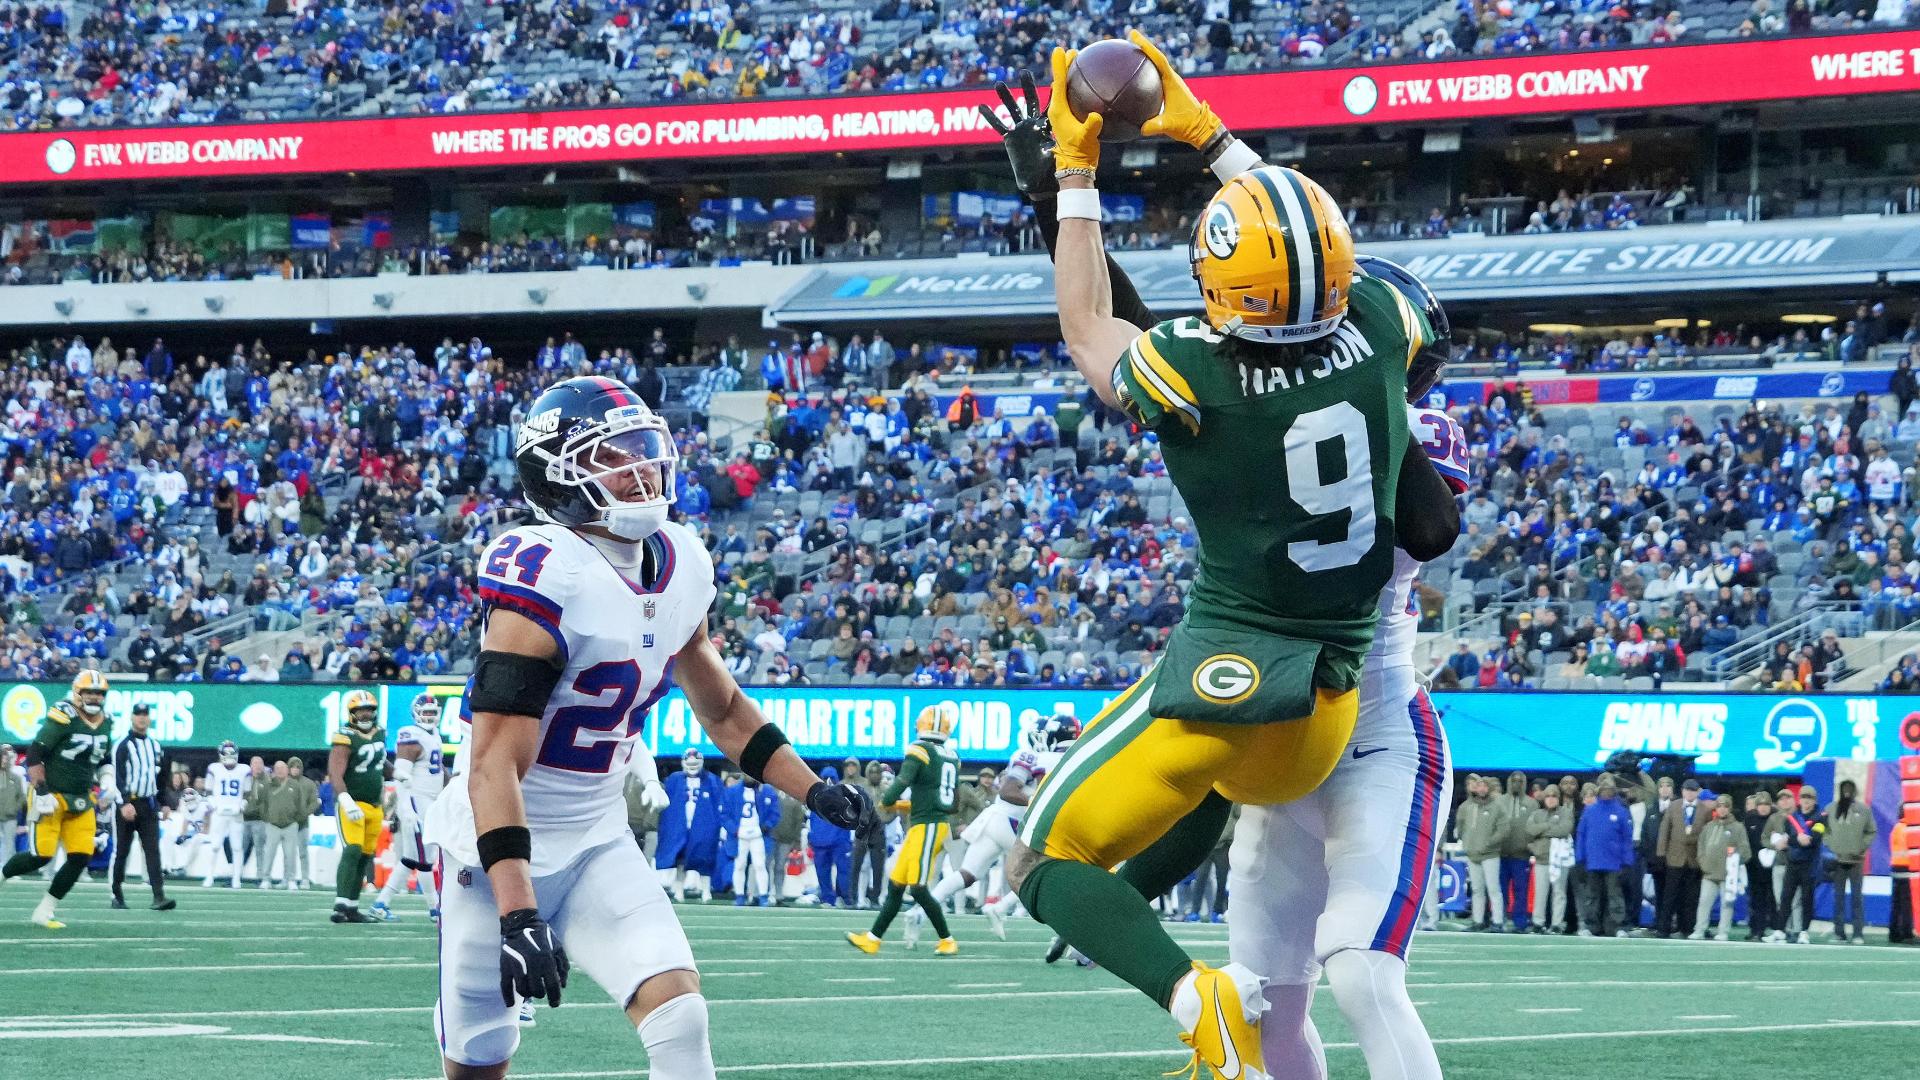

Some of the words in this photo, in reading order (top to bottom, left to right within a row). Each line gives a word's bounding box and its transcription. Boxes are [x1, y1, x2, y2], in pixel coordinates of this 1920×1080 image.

[1388, 79, 1433, 106] F.W.
[1437, 74, 1512, 102] WEBB
[1516, 65, 1650, 98] COMPANY
[1811, 49, 1905, 81] WHERE
[84, 143, 122, 167] F.W.
[126, 140, 190, 165] WEBB
[192, 136, 304, 163] COMPANY
[431, 129, 504, 154] WHERE
[508, 127, 549, 151] THE
[552, 124, 610, 149] PROS
[614, 122, 652, 147] GO
[655, 120, 700, 145] FOR
[702, 114, 829, 143] PLUMBING,
[832, 108, 940, 137] HEATING,
[1405, 247, 1606, 280] METLIFE
[1606, 236, 1837, 272] STADIUM
[895, 272, 1044, 293] MetLife
[1281, 324, 1322, 337] PACKERS
[1238, 319, 1375, 397] WASON
[1419, 413, 1469, 471] 38
[1283, 400, 1376, 573] 9
[486, 534, 553, 588] 24
[1197, 658, 1253, 699] G
[663, 697, 710, 744] 4T
[752, 698, 897, 746] UARTER
[938, 699, 1012, 750] 2ND
[1598, 702, 1728, 751] GIANTS
[1851, 721, 1877, 762] 3
[60, 733, 108, 764] 75
[221, 780, 240, 796] 19
[939, 762, 957, 806] 0
